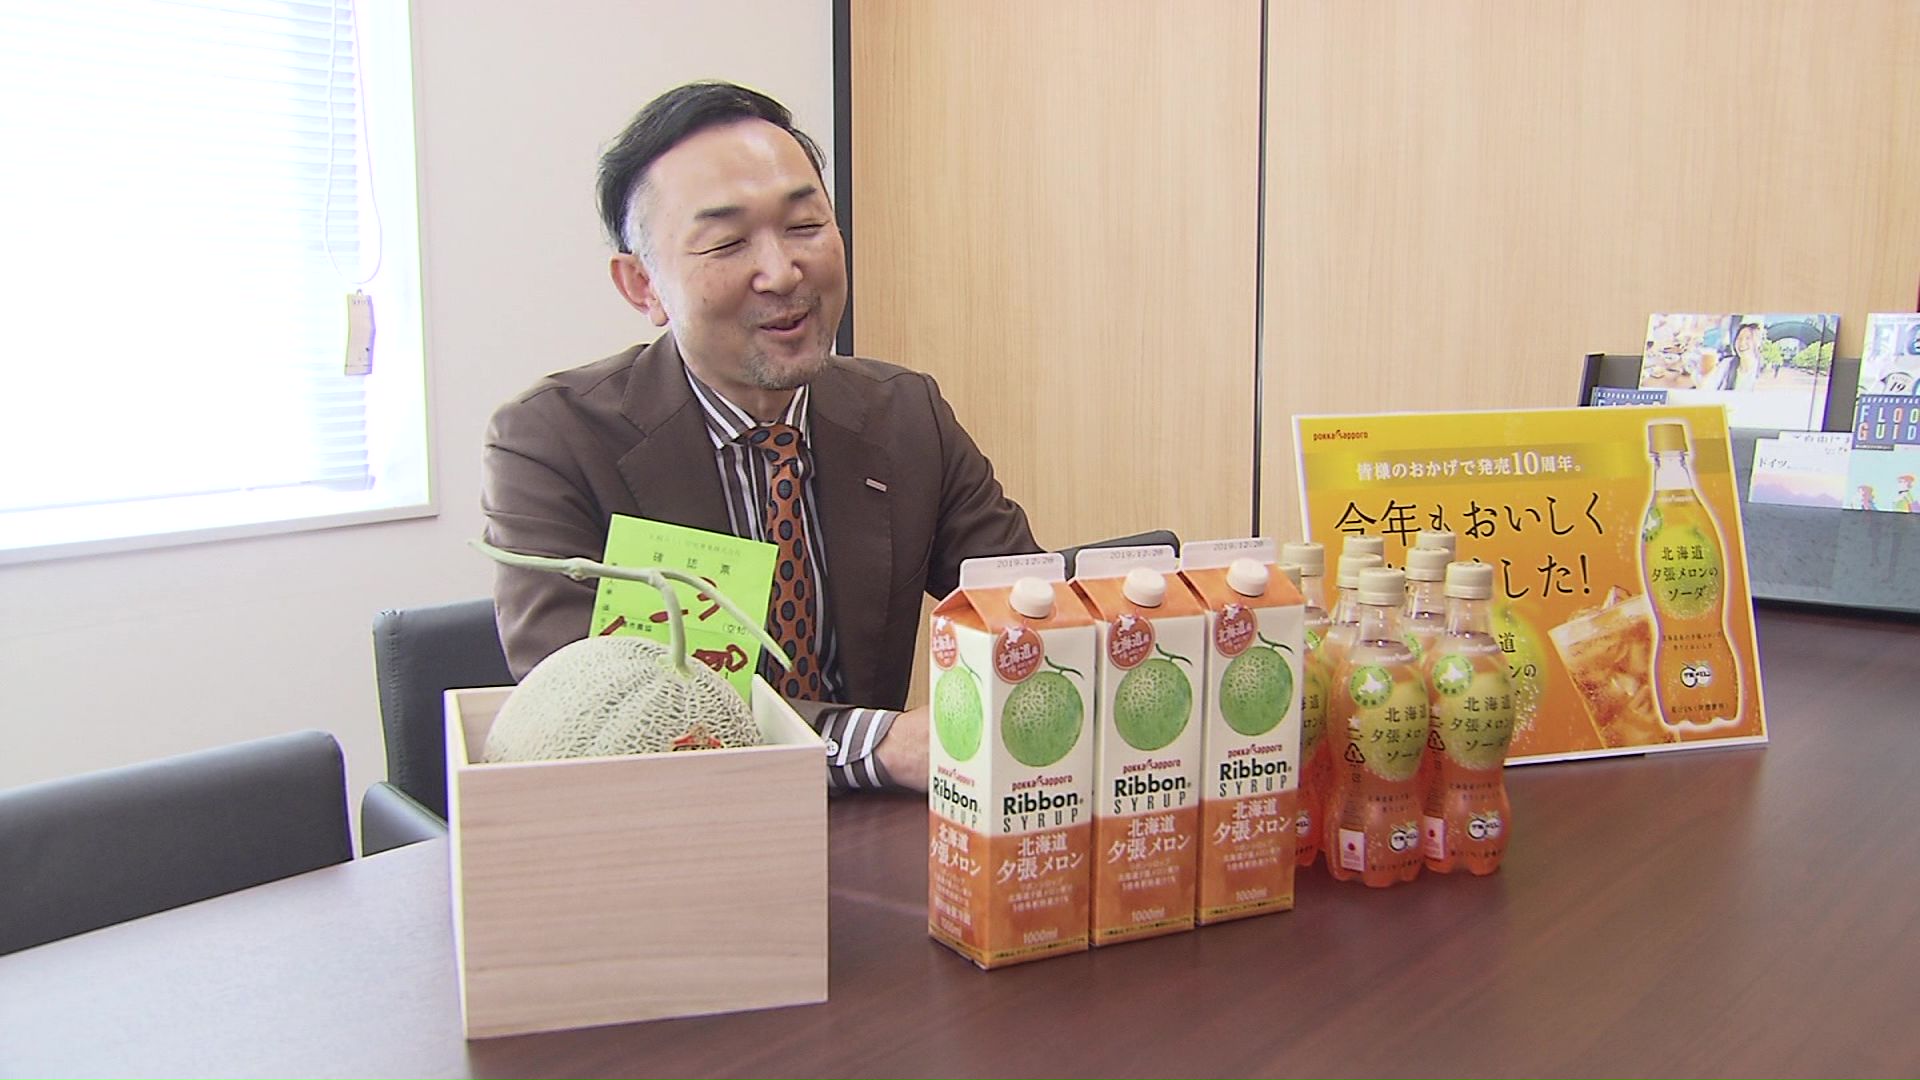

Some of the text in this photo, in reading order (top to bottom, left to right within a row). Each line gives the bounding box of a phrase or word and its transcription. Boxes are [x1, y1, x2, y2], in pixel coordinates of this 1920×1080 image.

[1356, 451, 1583, 482] 皆様のおかげで発売10周年。
[1661, 544, 1704, 561] 北海道
[1651, 567, 1719, 582] 夕張メロンの
[1668, 584, 1708, 602] ソーダ
[1219, 758, 1288, 782] Ribbon
[933, 777, 978, 813] Ribbon
[1114, 774, 1187, 798] Ribbon
[1219, 774, 1288, 798] SYRUP
[934, 797, 977, 830] SYRUP
[1003, 791, 1078, 816] Ribbon
[1114, 791, 1187, 815] SYRUP
[1231, 798, 1278, 820] 北海道
[1003, 808, 1078, 834] SYRUP
[1127, 815, 1176, 838] 北海道
[1213, 817, 1292, 846] 夕張メロン
[939, 824, 968, 852] 北海道
[1018, 833, 1067, 857] 北海道
[1107, 834, 1192, 864] 夕張メロン
[930, 837, 981, 877] 夕張メロン
[997, 852, 1084, 885] 夕張メロン
